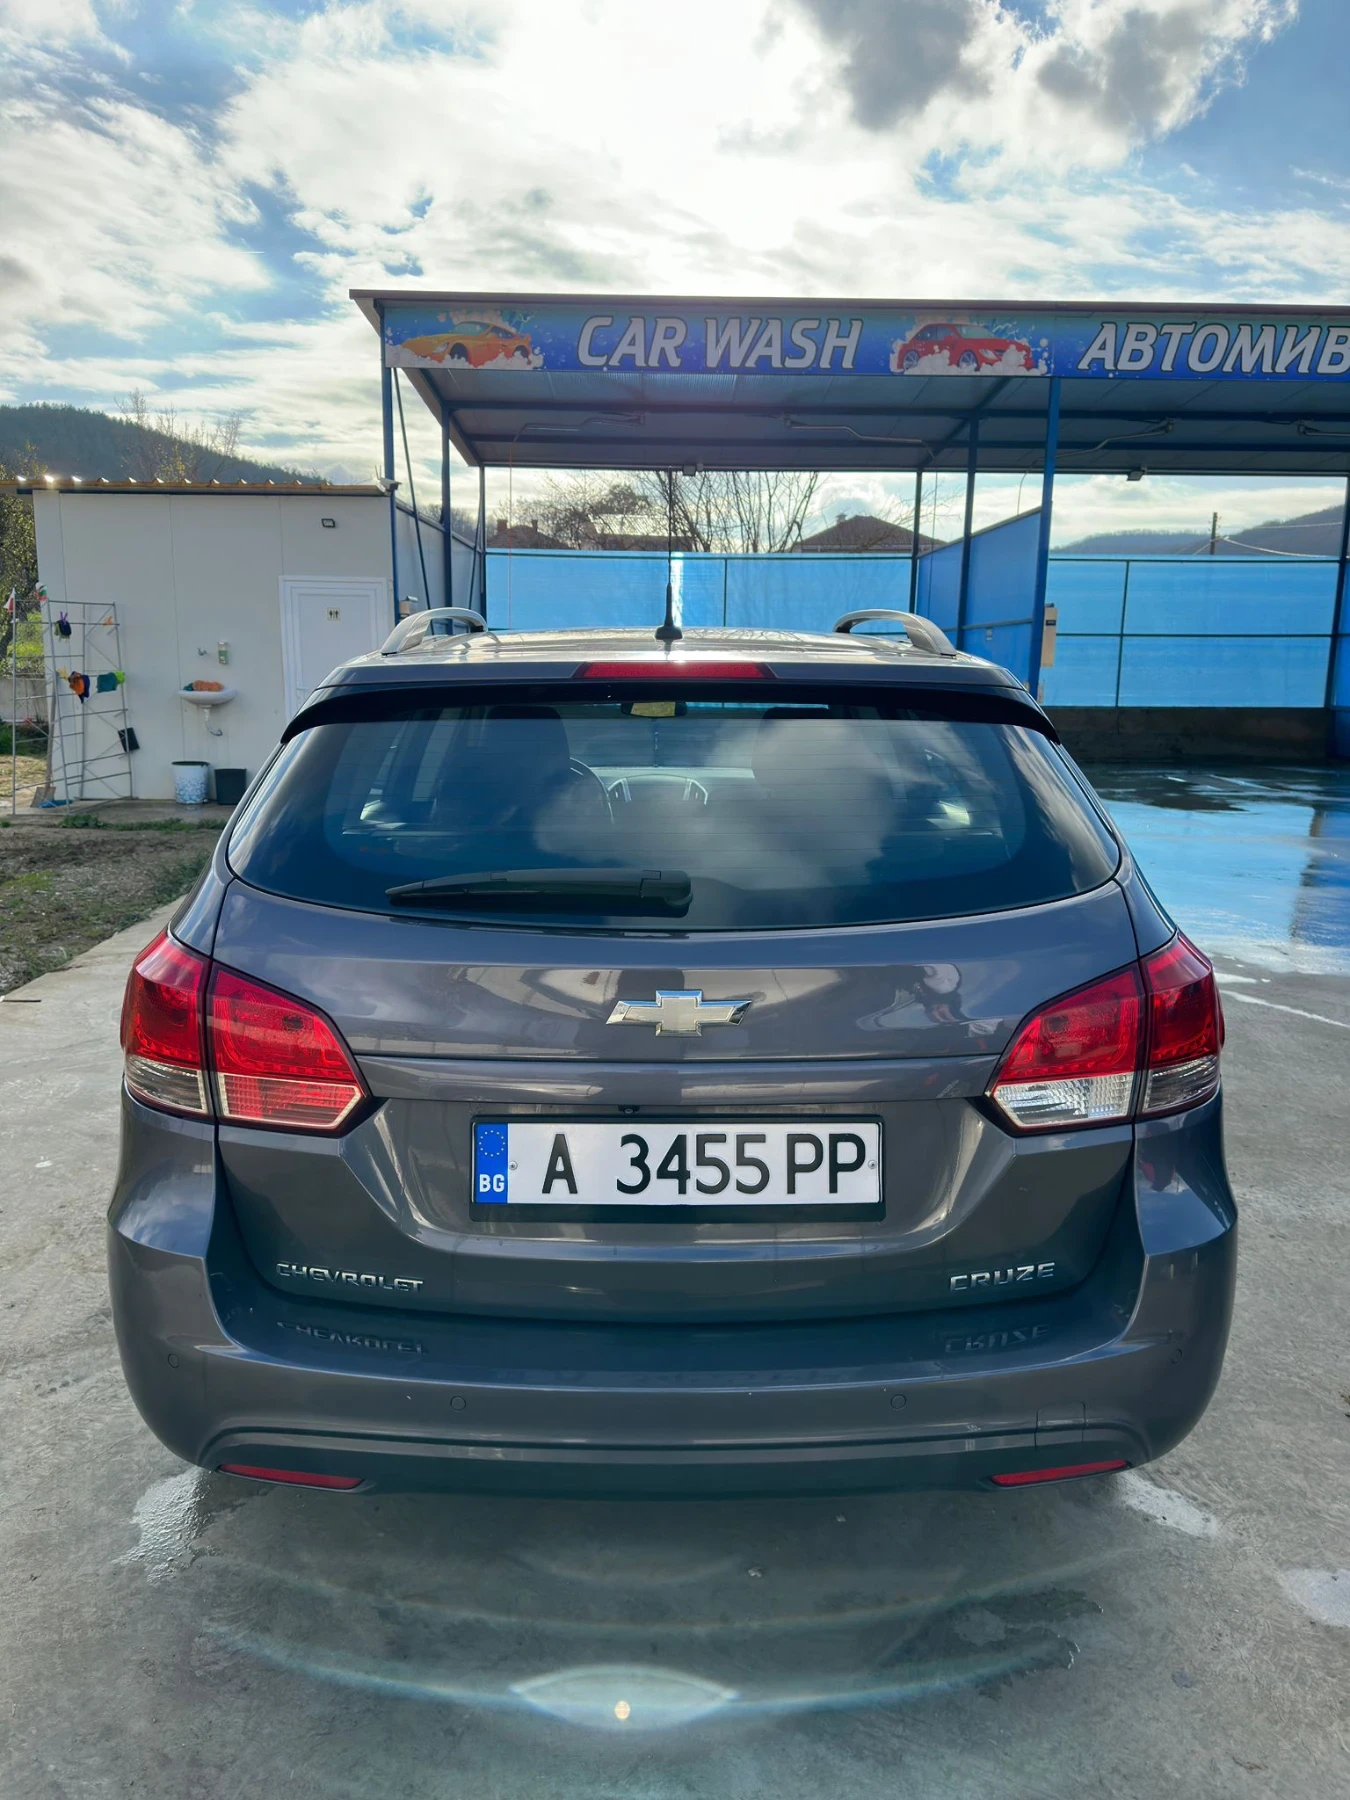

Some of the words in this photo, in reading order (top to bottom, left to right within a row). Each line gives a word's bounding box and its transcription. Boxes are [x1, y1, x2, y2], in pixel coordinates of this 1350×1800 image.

[576, 315, 688, 369] CAR
[703, 316, 864, 370] WASH
[1077, 321, 1350, 375] АВТОМИВ
[479, 1173, 505, 1193] BG
[541, 1133, 578, 1194] A
[275, 1261, 424, 1293] CHEVROLET
[949, 1261, 1056, 1293] CRUZE
